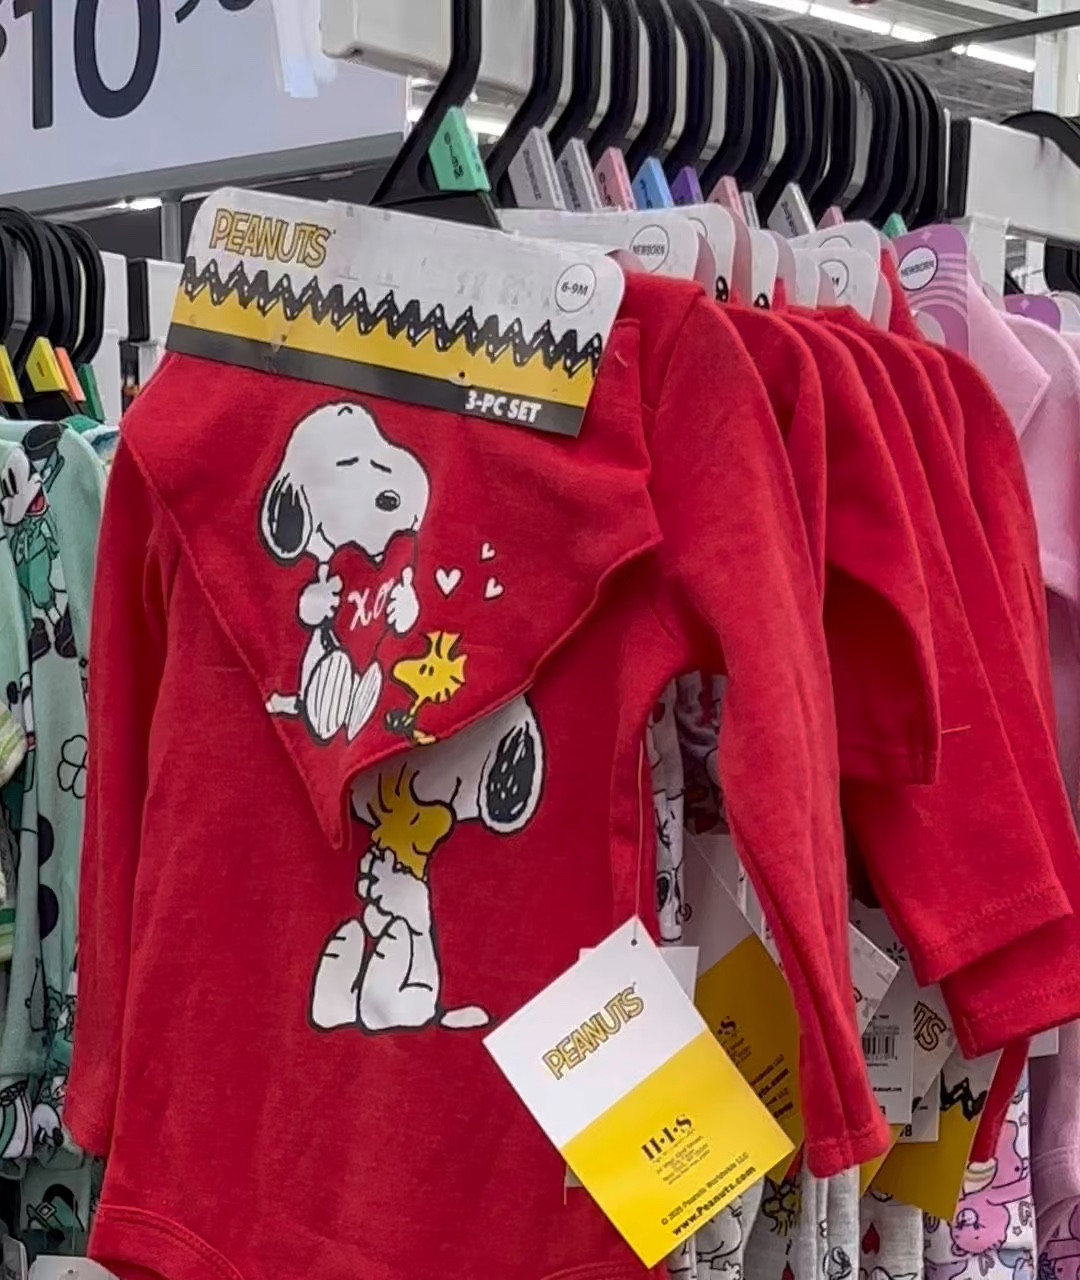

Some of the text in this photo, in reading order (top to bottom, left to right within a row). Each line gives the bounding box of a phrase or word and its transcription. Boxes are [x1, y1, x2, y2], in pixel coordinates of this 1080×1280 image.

[210, 208, 331, 268] PEANUTS
[559, 280, 589, 297] 6-9M
[465, 389, 541, 424] 3-PC SET
[542, 985, 645, 1081] PEANUTS
[672, 1164, 757, 1237] www.Peanuts.com
